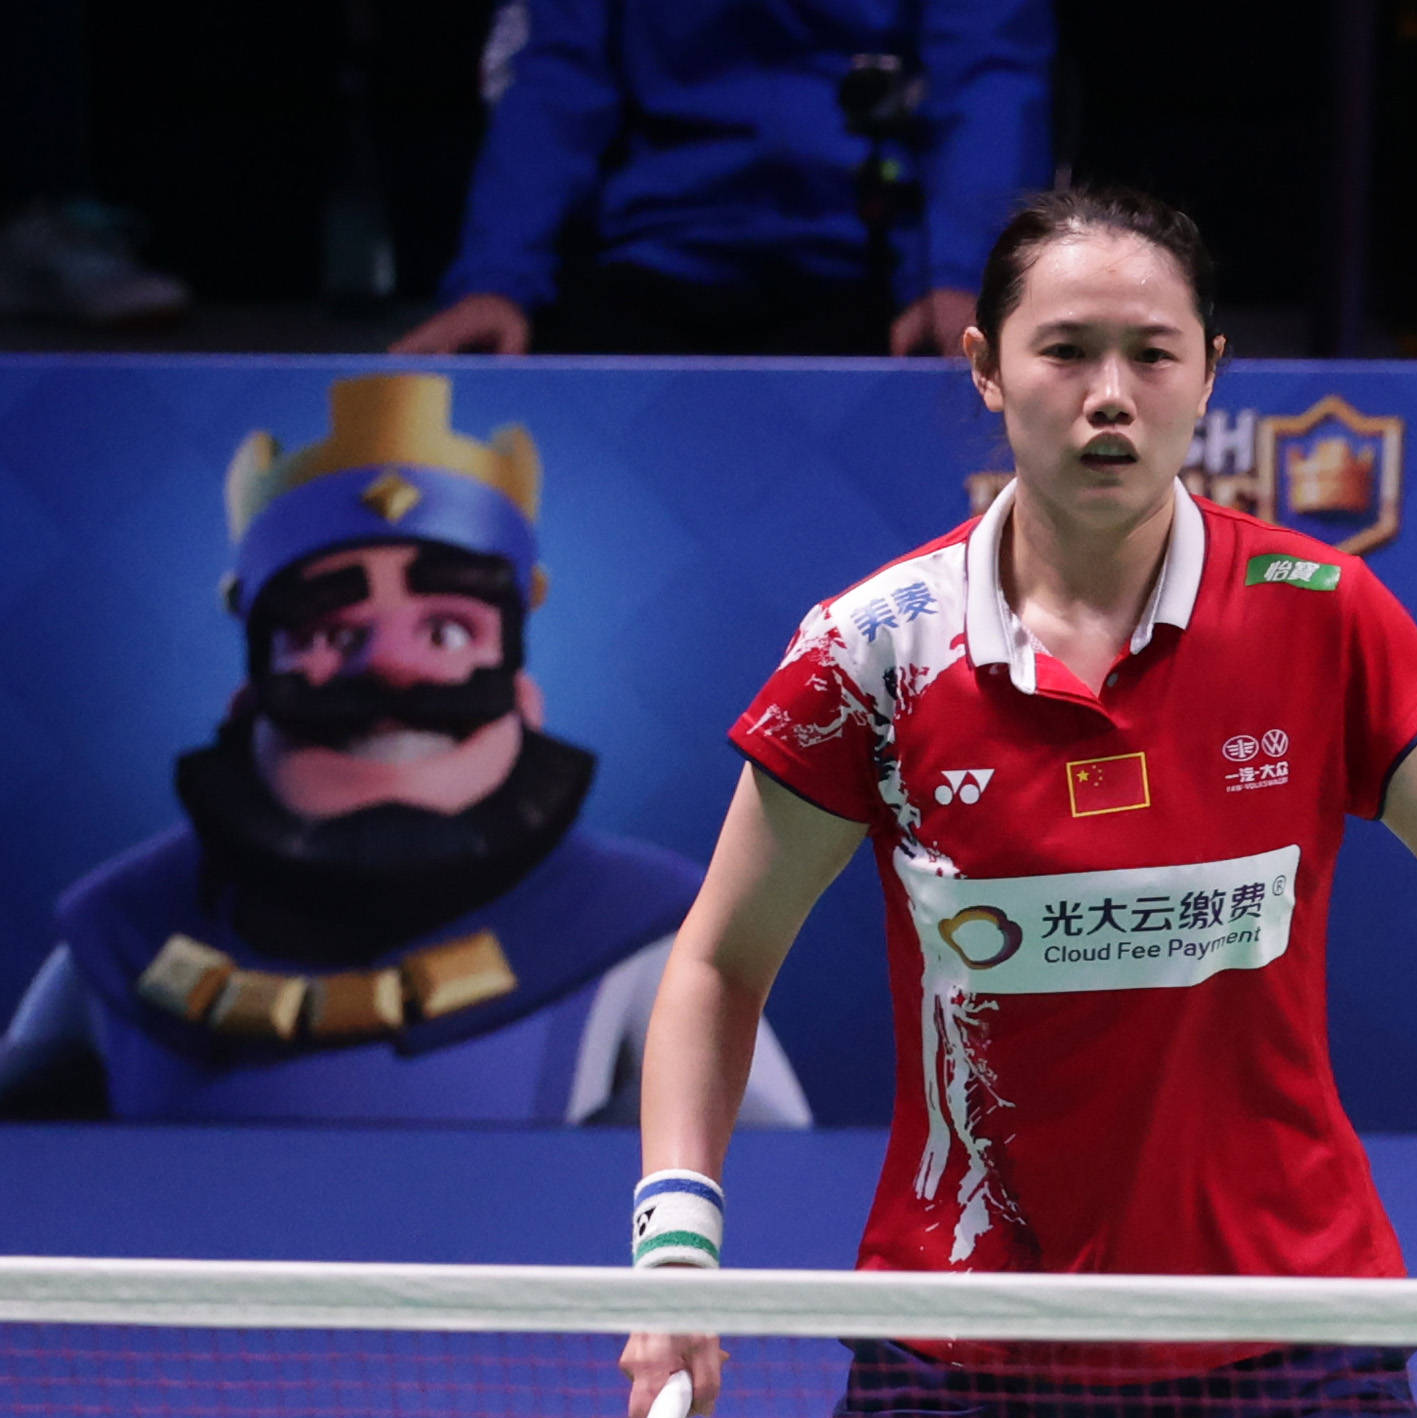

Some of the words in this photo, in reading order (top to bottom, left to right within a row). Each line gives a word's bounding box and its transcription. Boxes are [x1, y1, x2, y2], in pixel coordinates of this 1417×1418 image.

[850, 582, 939, 643] 美菱
[1041, 882, 1266, 939] 光大云缴费
[1043, 943, 1111, 963] Cloud
[1117, 942, 1161, 960] Fee
[1168, 926, 1262, 961] Payment
